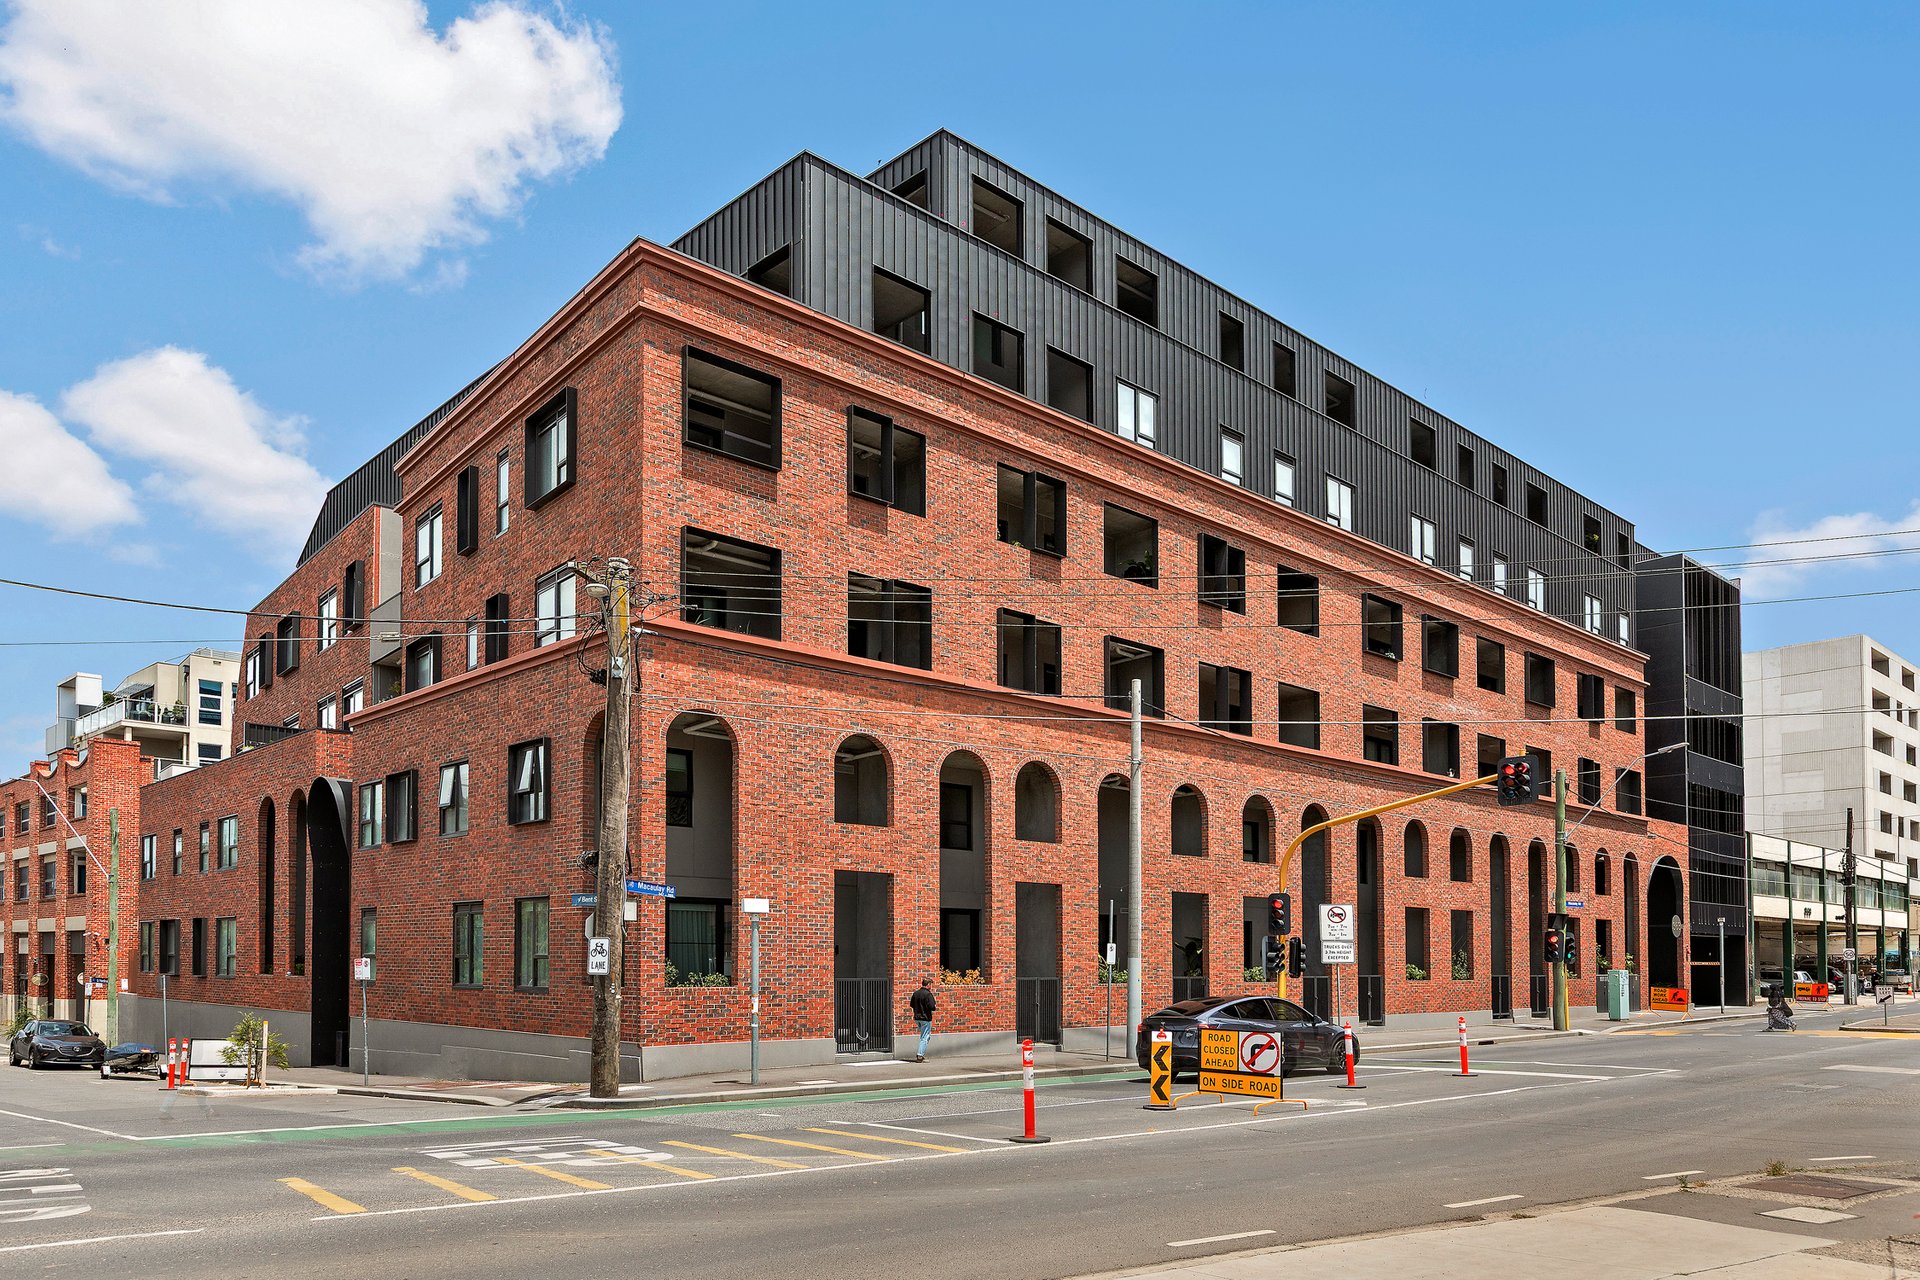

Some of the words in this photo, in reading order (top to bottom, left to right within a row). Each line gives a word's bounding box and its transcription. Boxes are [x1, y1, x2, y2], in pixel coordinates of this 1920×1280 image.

[637, 881, 665, 893] Macaulay
[590, 961, 606, 970] LANE
[1208, 1033, 1231, 1042] ROAD
[1203, 1045, 1236, 1055] CLOSED
[1204, 1058, 1234, 1068] AHEAD
[1202, 1076, 1216, 1087] ON
[1221, 1078, 1244, 1089] SIDE
[1249, 1081, 1278, 1093] ROAD
